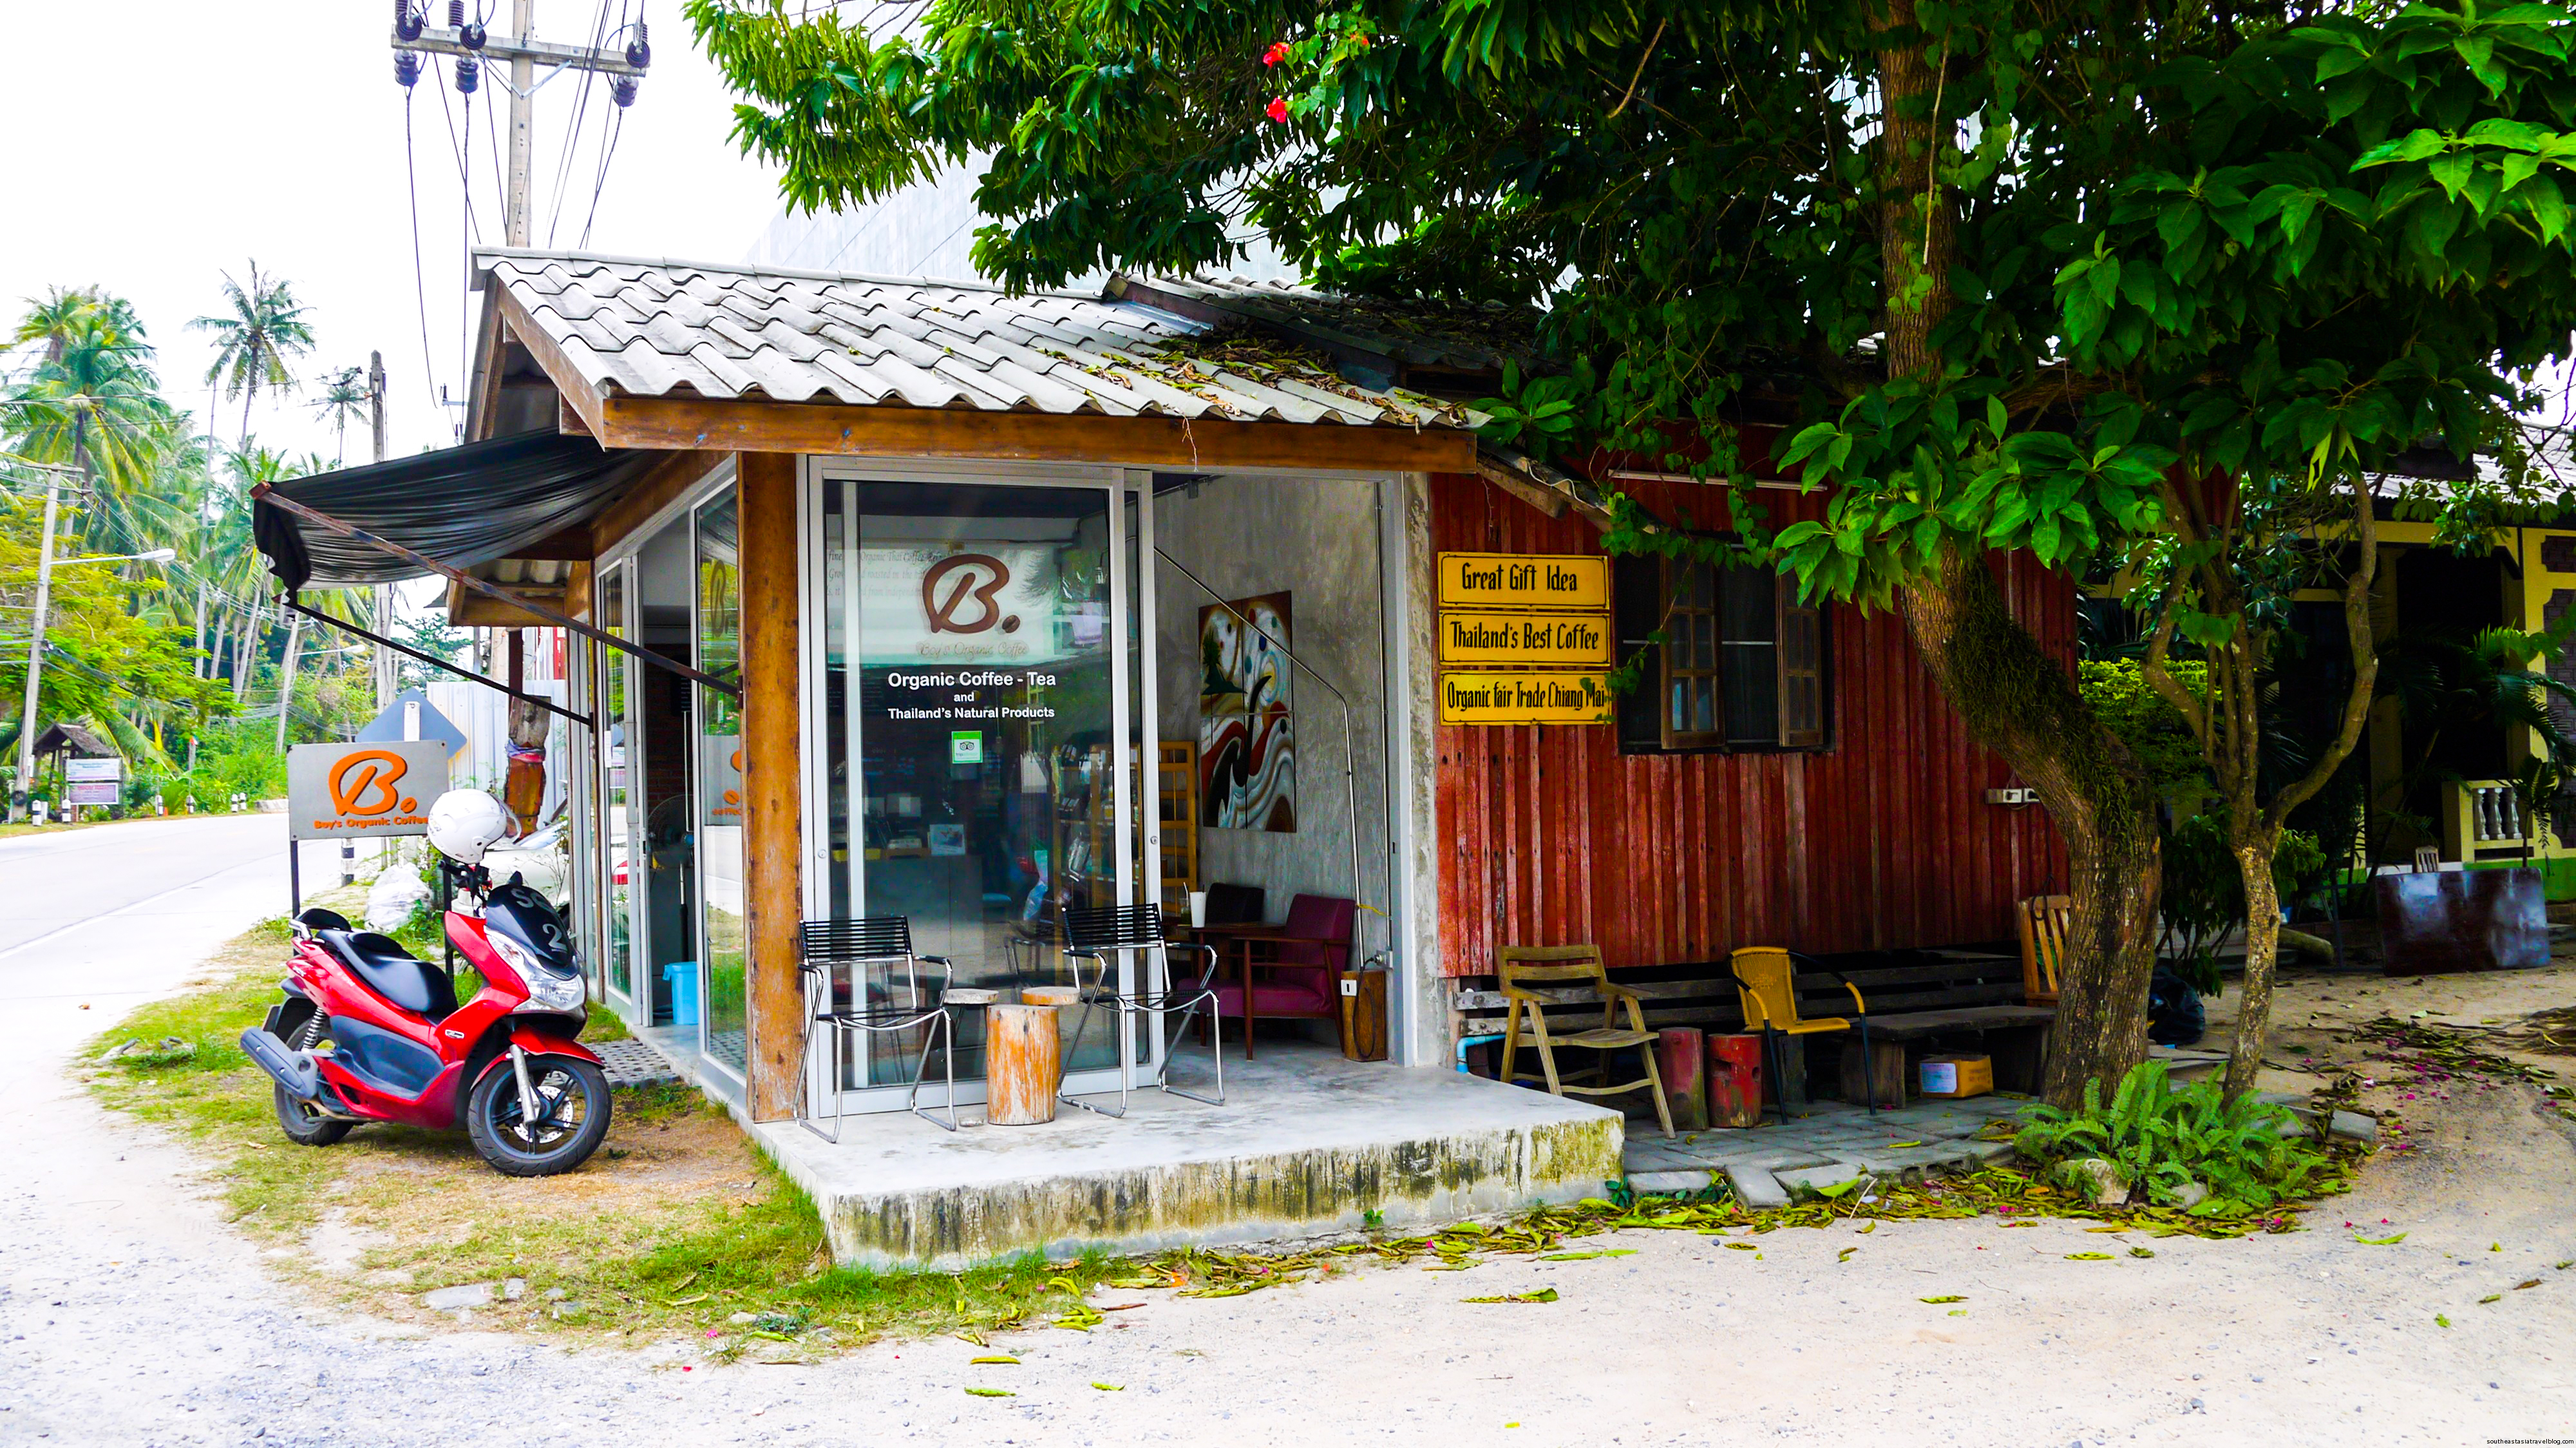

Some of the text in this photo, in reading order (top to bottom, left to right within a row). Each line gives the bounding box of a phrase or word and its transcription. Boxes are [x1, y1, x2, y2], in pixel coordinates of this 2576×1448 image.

[1462, 562, 1577, 591] Great Gift Idea
[1450, 621, 1598, 649] Thailand's Best Coffee
[888, 672, 954, 690] Organic
[960, 671, 1013, 686] Coffee
[1027, 672, 1056, 686] Tea
[954, 692, 974, 702] and
[1448, 681, 1490, 711] Organic
[1515, 681, 1545, 708] Trade
[1548, 681, 1582, 710] Chiang
[1586, 682, 1604, 707] Mai
[888, 707, 1055, 719] Thailand's Natural Products
[346, 817, 391, 829] Organic
